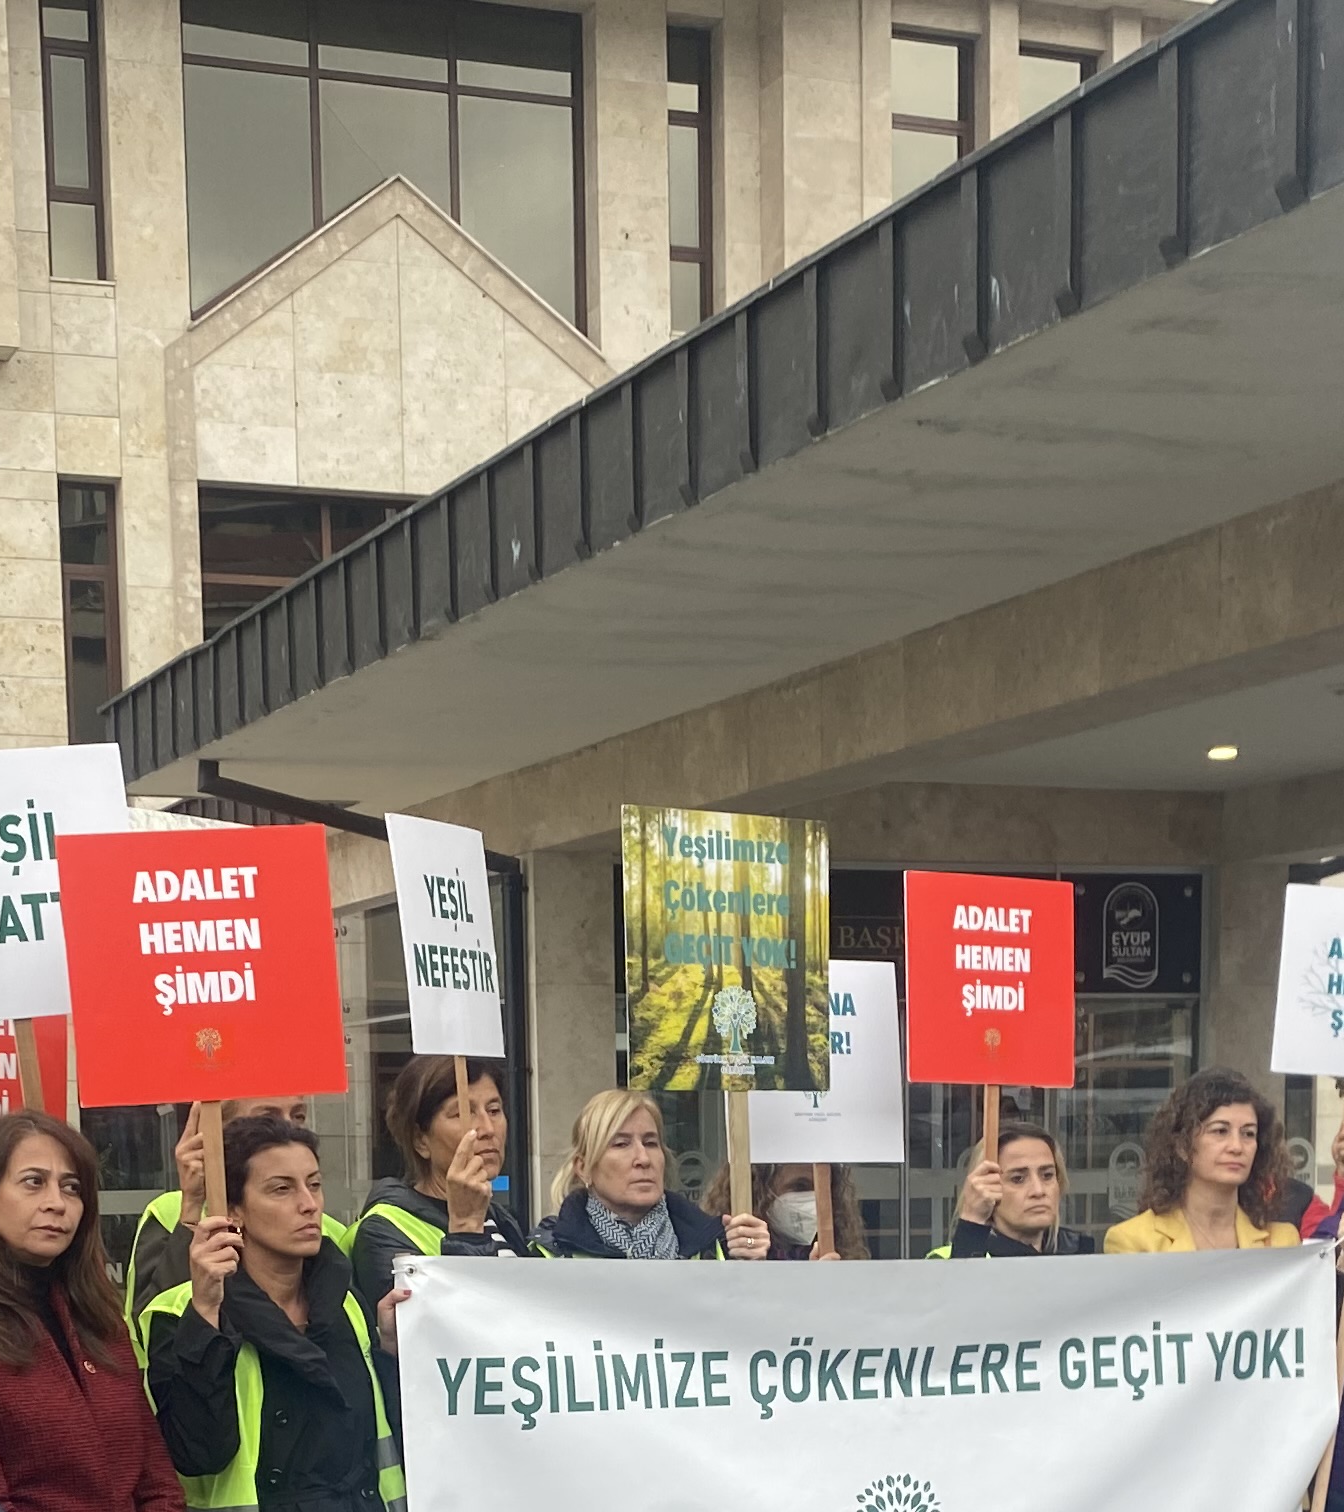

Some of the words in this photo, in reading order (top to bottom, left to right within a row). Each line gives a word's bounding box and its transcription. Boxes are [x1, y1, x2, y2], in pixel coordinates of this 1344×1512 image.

[662, 824, 789, 868] Yeşilimize
[132, 866, 258, 904] ADALET
[423, 867, 474, 932] YEŞİL
[663, 880, 790, 920] Çökenlere
[139, 918, 262, 955] HEMEN
[953, 904, 1032, 934] ADALET
[413, 939, 495, 993] NEFESTİR
[664, 928, 733, 974] GEÇİT
[741, 936, 797, 969] YOK!
[955, 944, 1031, 973] HEMEN
[154, 962, 257, 1016] ŞİMDİ
[962, 979, 1025, 1016] ŞİMDİ
[436, 1338, 731, 1431] YEŞİLİMİZE
[749, 1337, 1042, 1420] ÇÖKENLERE
[1059, 1321, 1193, 1401] GEÇİT
[1206, 1327, 1305, 1382] YOK!
